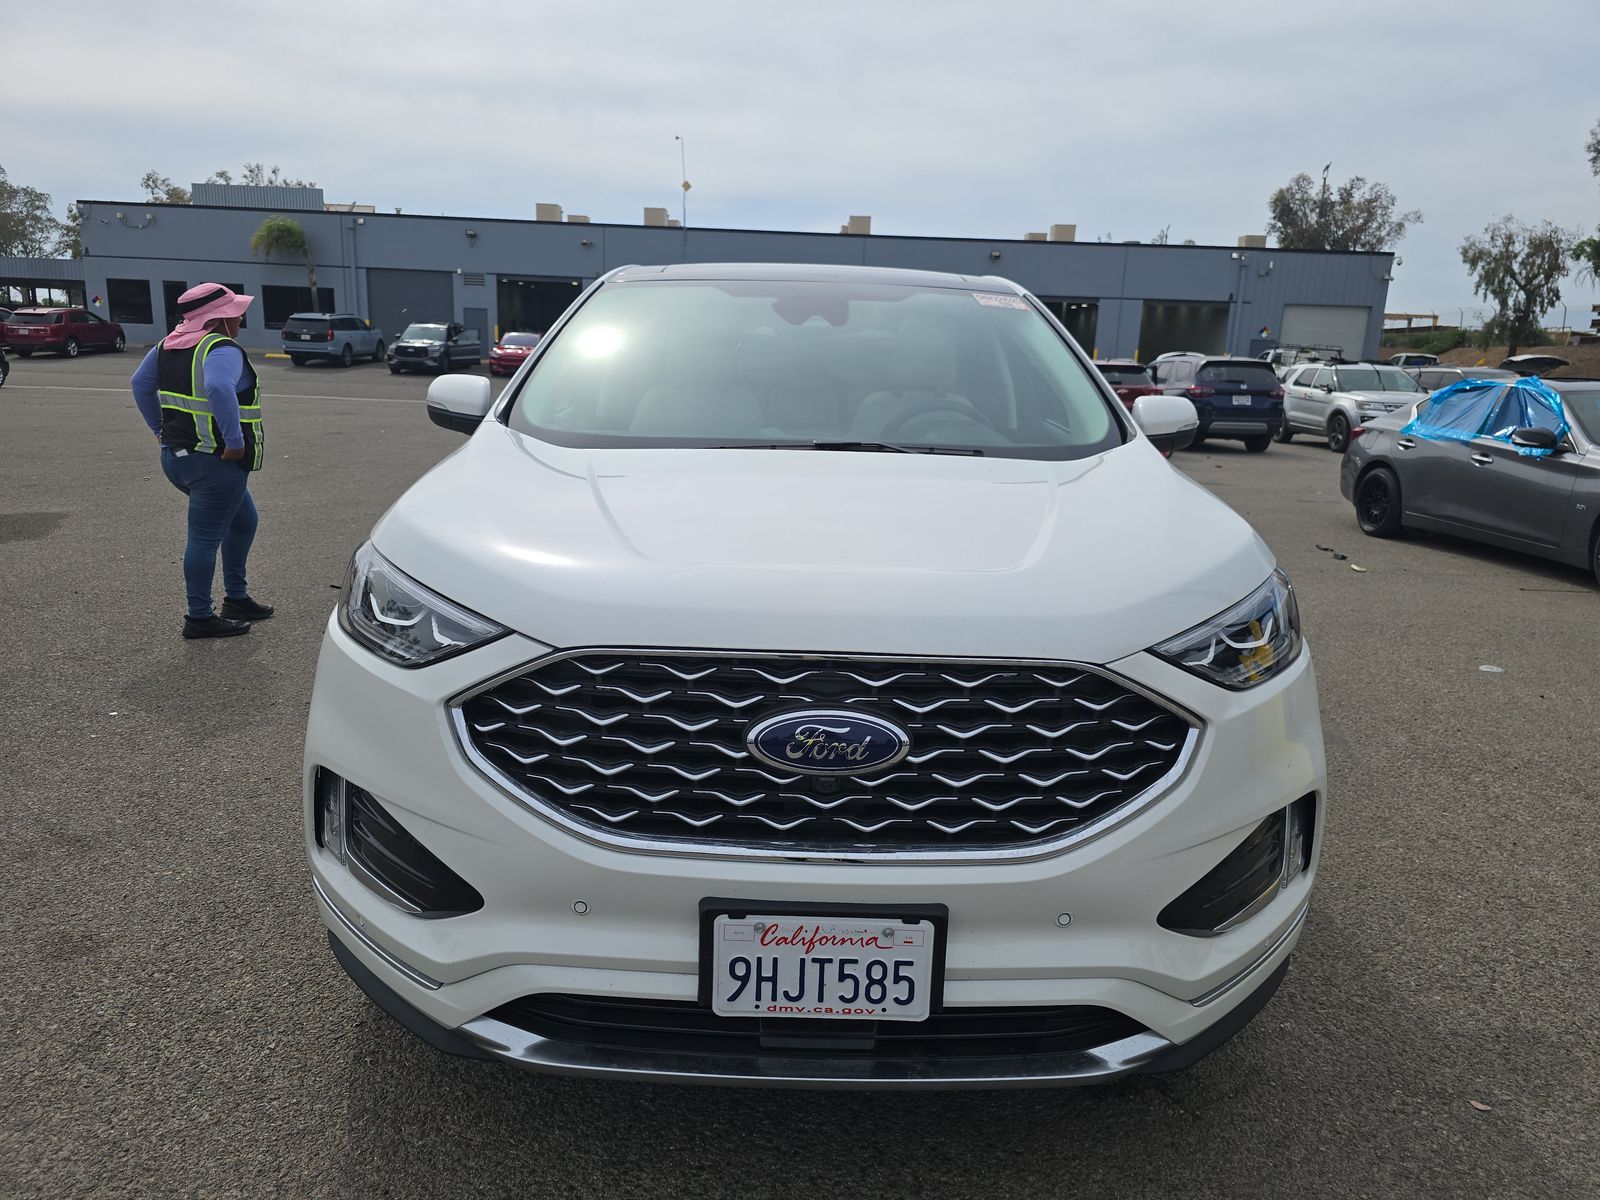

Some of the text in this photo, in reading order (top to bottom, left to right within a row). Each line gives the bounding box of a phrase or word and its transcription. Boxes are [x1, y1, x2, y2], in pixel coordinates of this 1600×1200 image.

[786, 724, 872, 760] Ford
[760, 924, 893, 954] California
[726, 956, 915, 1006] 9HJT585
[767, 1004, 877, 1015] dmv.ca.gov
